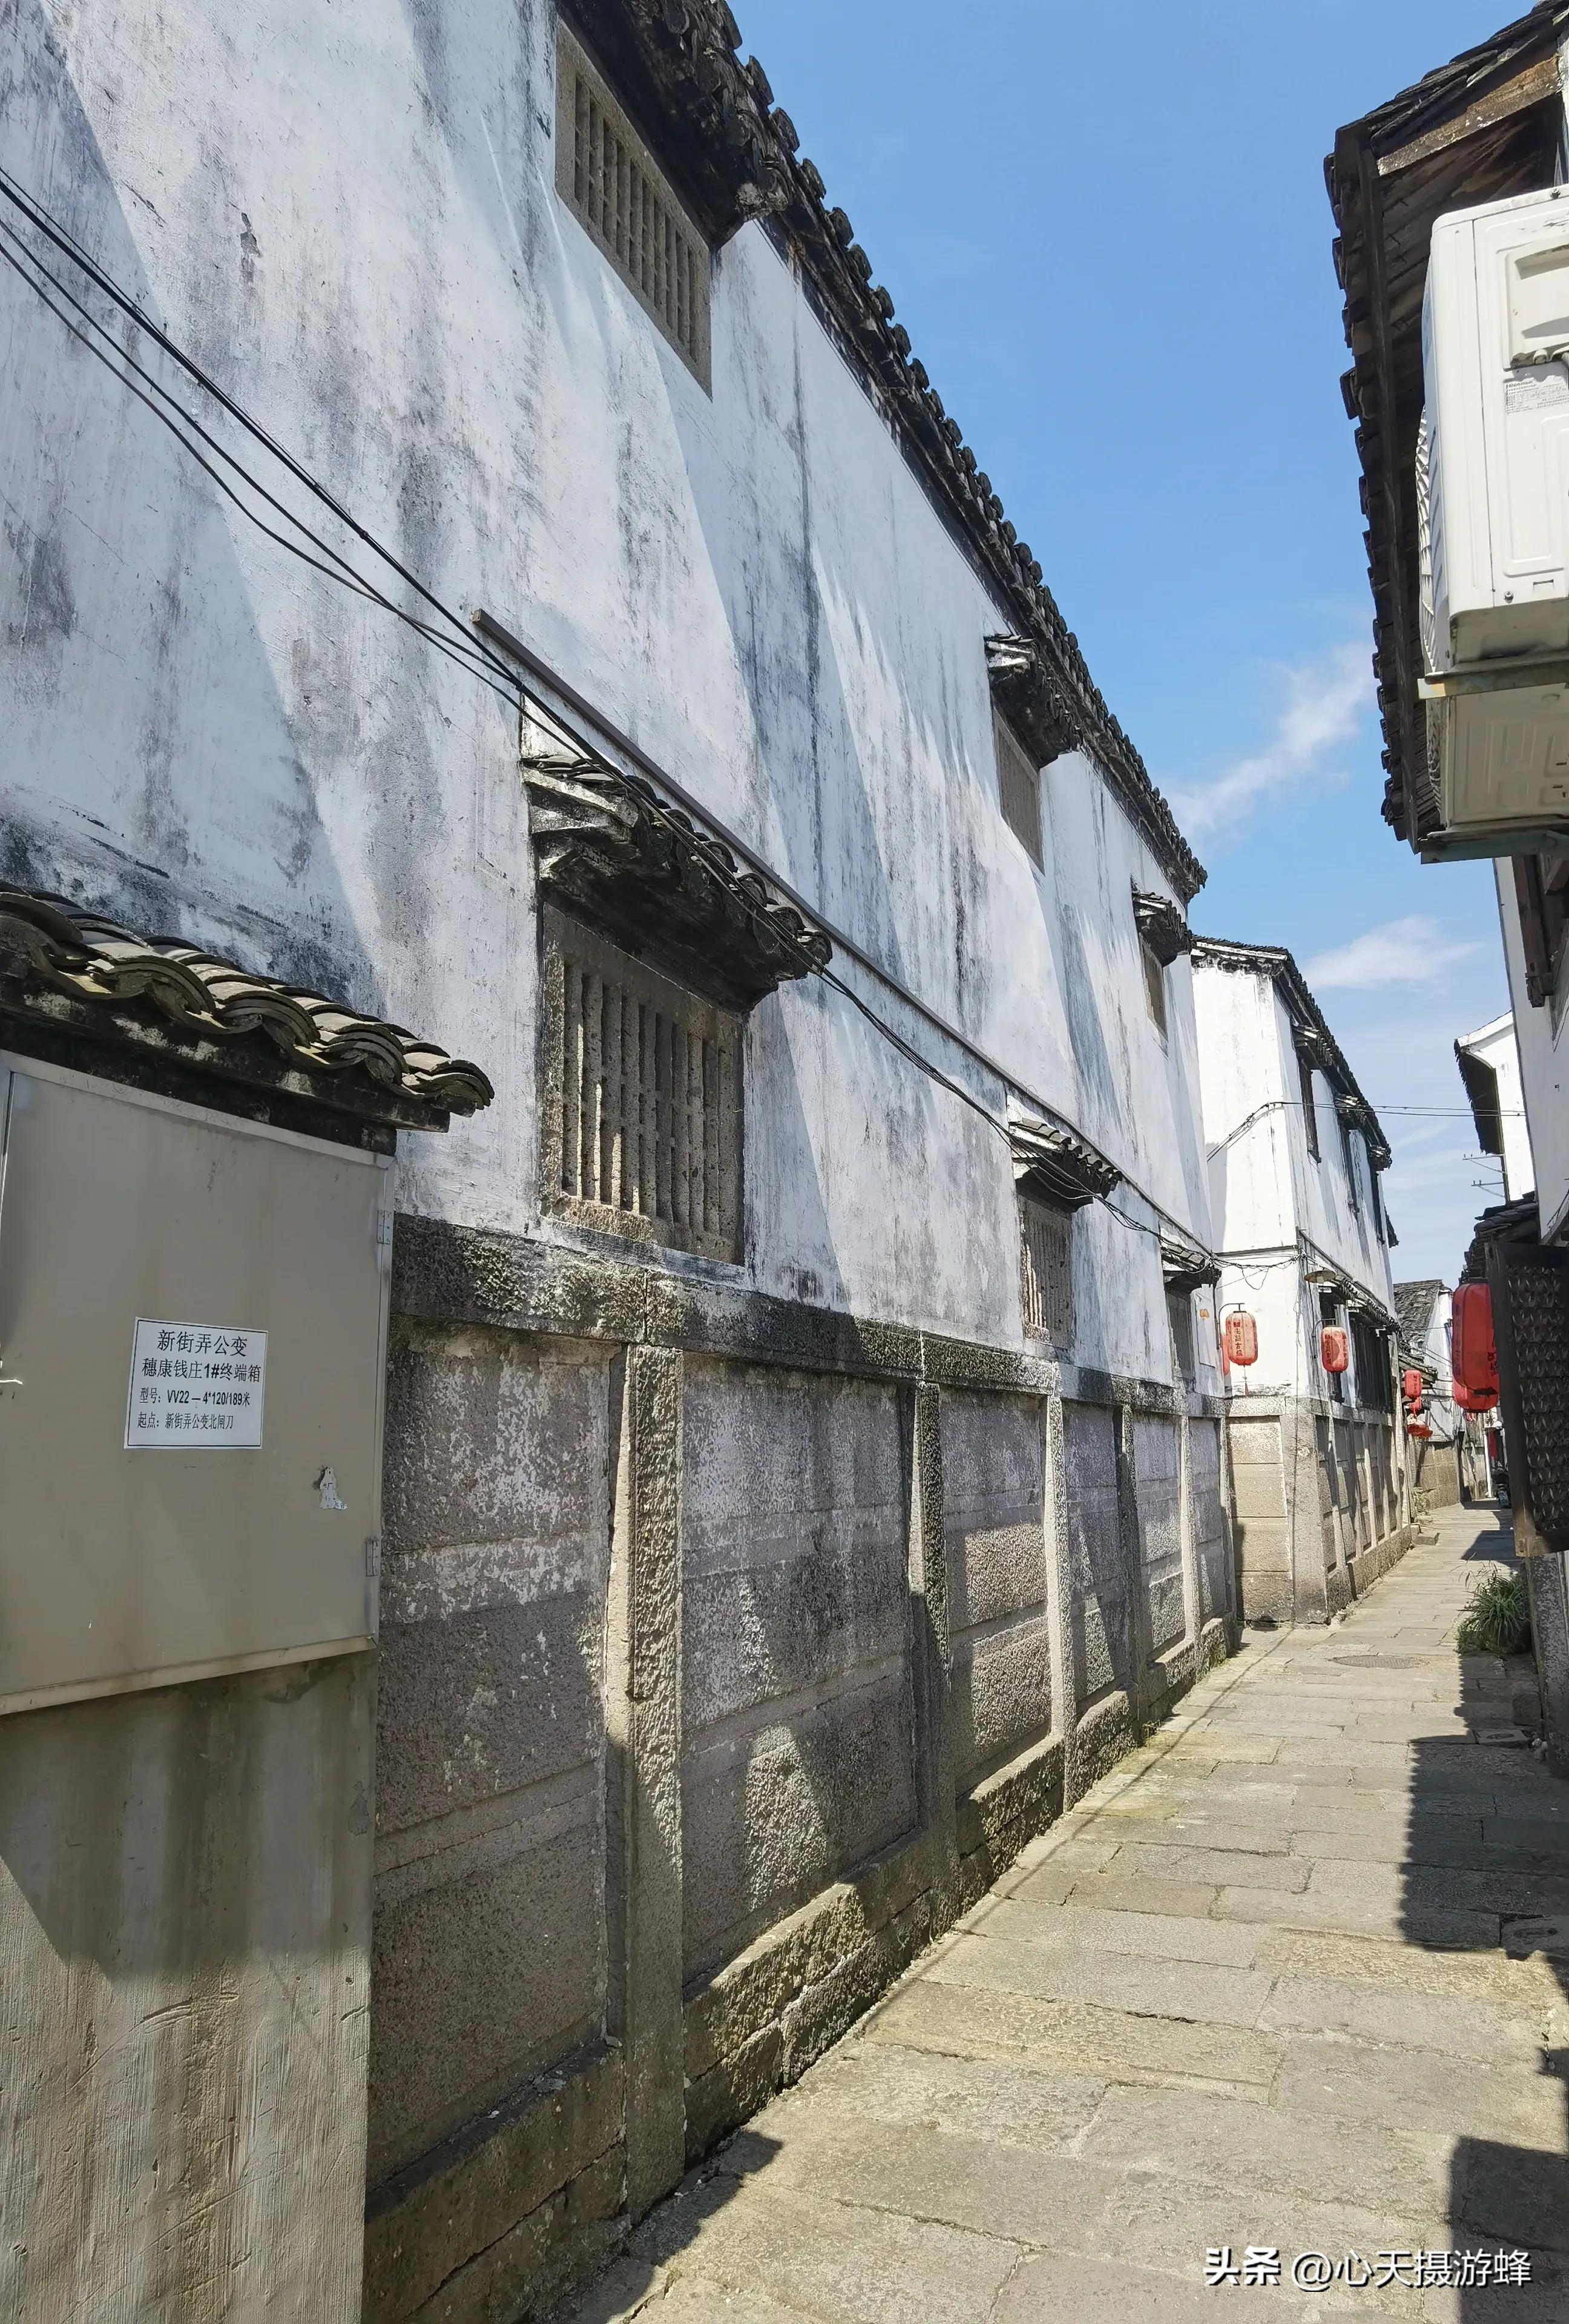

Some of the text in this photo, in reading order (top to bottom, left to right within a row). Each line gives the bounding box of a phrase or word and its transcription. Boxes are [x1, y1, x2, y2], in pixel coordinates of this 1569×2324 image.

[157, 1330, 248, 1356] 新街弄公变
[142, 1358, 262, 1383] 穗康钱庄1#终端箱
